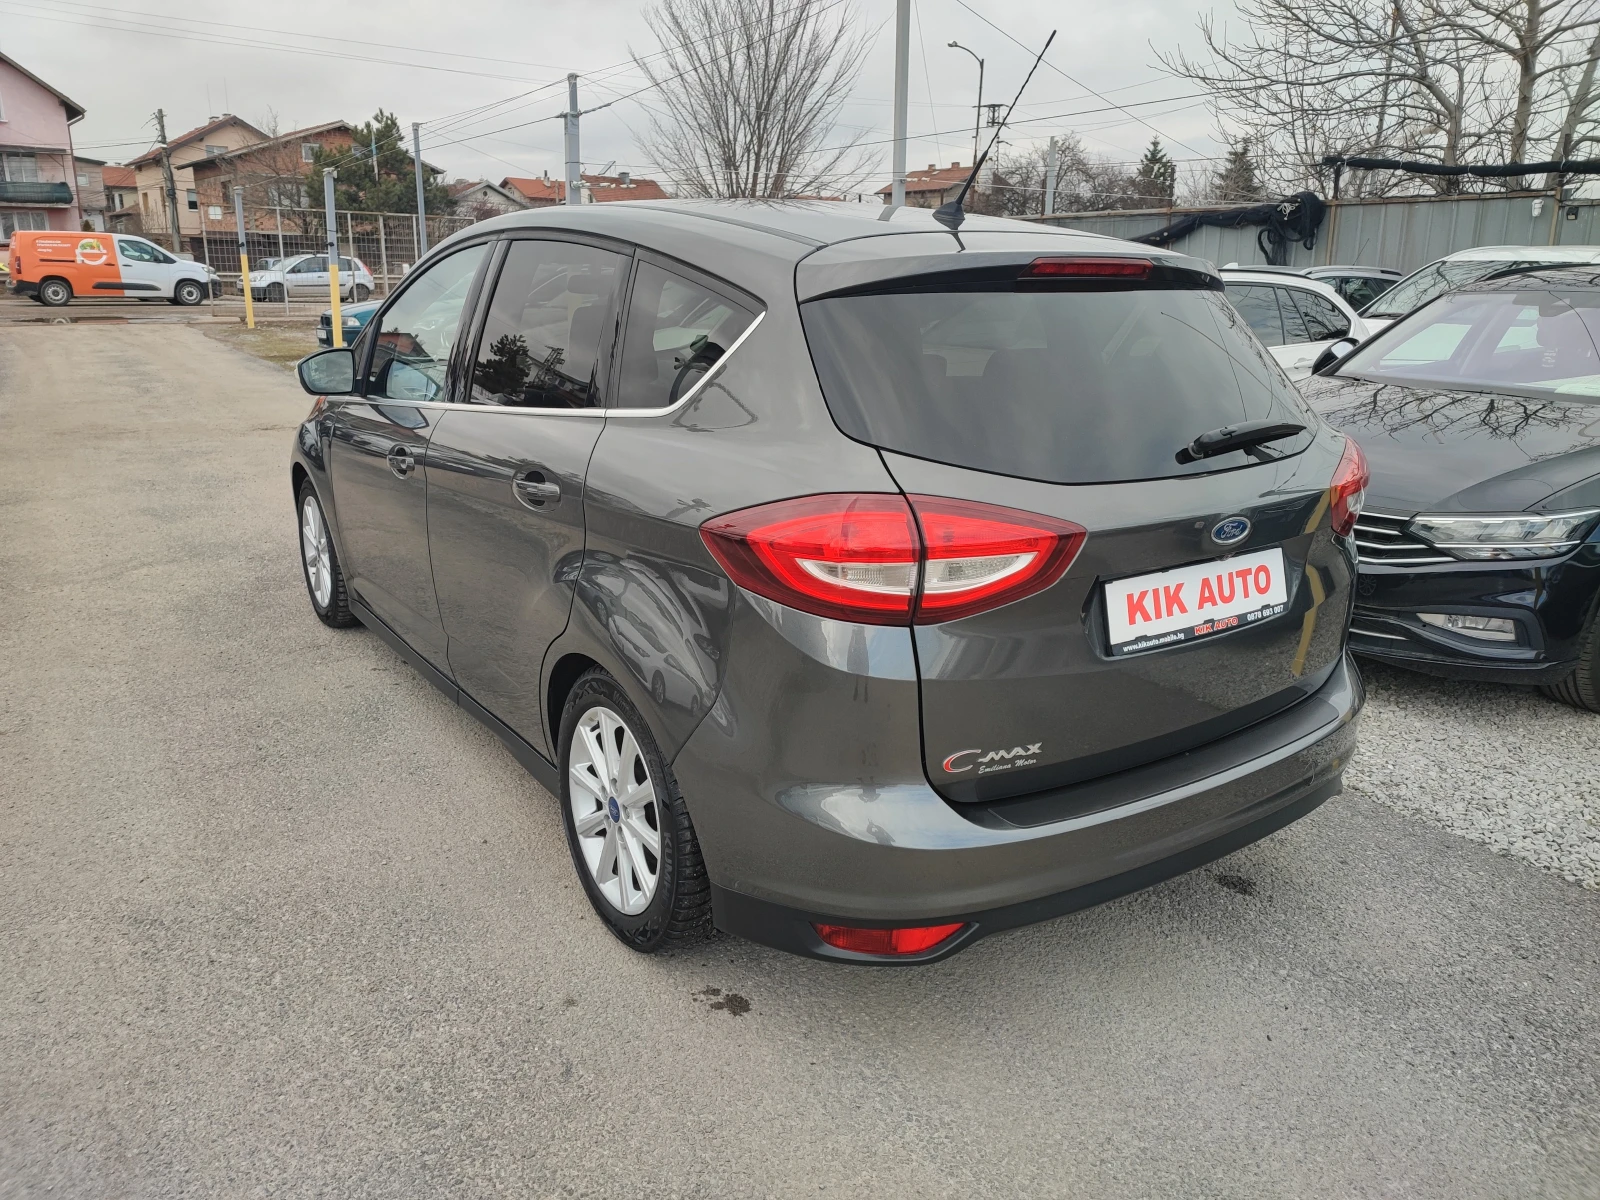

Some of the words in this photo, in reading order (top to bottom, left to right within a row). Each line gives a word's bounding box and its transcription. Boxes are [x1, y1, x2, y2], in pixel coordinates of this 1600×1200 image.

[1221, 522, 1242, 539] Ford
[1126, 582, 1188, 626] KIK
[1197, 564, 1271, 611] AUTO
[1262, 608, 1273, 617] 693
[1274, 605, 1284, 614] 007
[1194, 623, 1213, 635] KIK
[1214, 617, 1238, 630] AUTO
[1123, 632, 1184, 652] www.kikauto.mobile.bg
